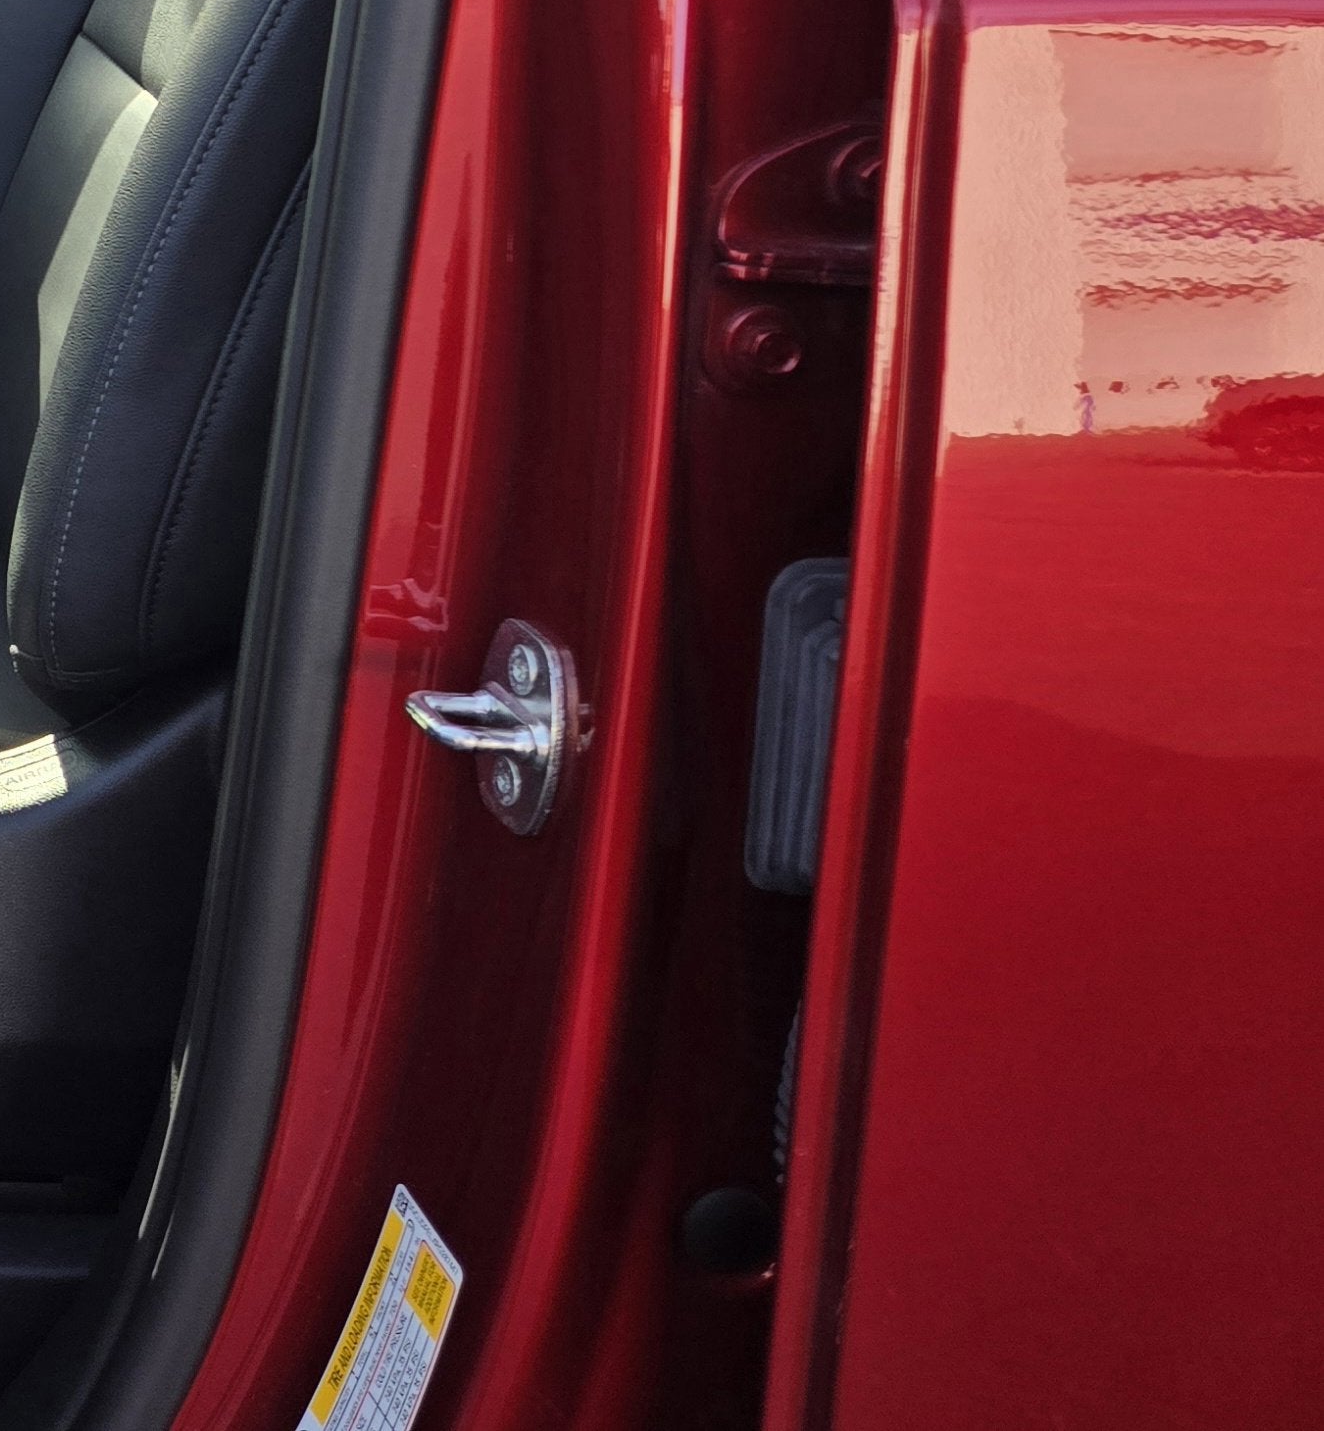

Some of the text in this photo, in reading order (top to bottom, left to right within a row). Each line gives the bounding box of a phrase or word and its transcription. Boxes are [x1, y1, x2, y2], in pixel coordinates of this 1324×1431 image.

[327, 1365, 344, 1392] TIRE
[338, 1345, 353, 1371] AND
[346, 1304, 369, 1351] LOADING
[362, 1245, 392, 1310] INFORMATION
